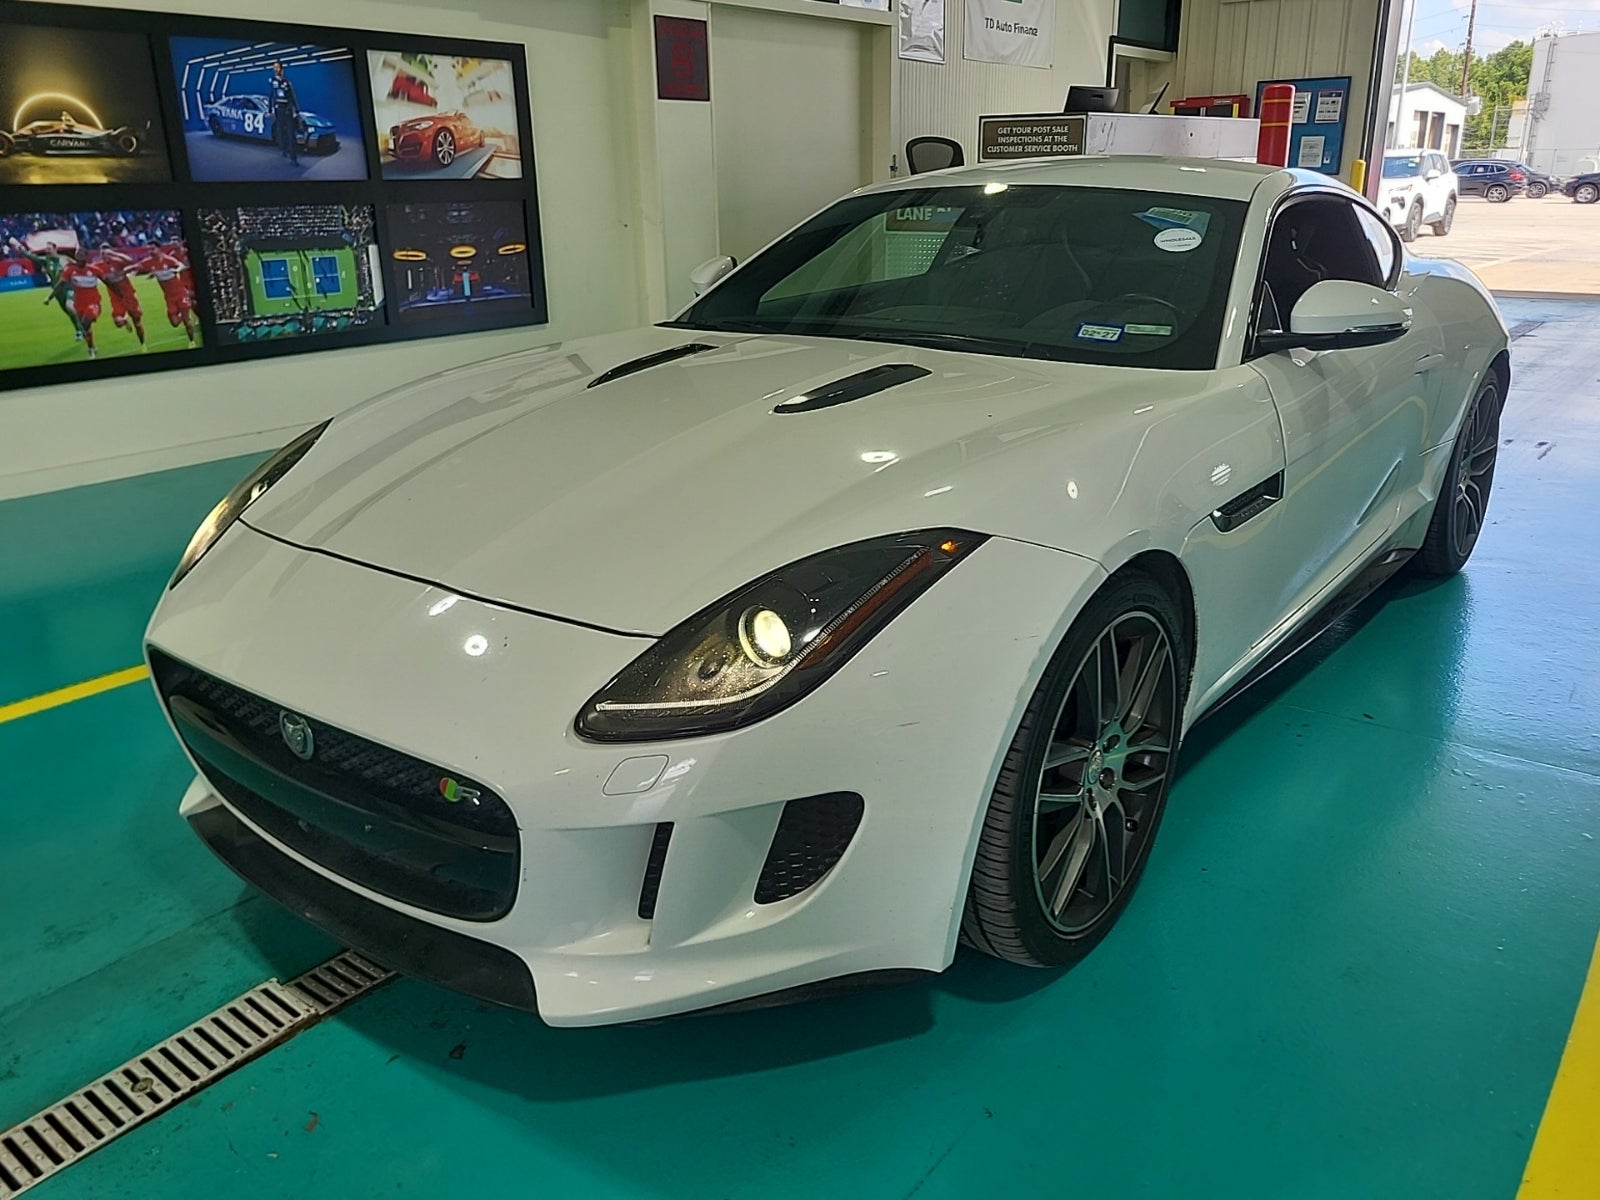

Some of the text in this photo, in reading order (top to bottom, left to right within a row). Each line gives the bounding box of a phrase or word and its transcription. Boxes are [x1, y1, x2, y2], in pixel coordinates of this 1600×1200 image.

[984, 17, 995, 29] TD
[996, 20, 1012, 33] Auto
[244, 112, 264, 134] 84
[997, 125, 1069, 135] GET YOUR POST SALE
[997, 135, 1068, 144] INSPECTIONS AT THE
[987, 144, 1078, 153] CUSTOMER SERVICE BOOTH
[896, 207, 932, 220] LANE
